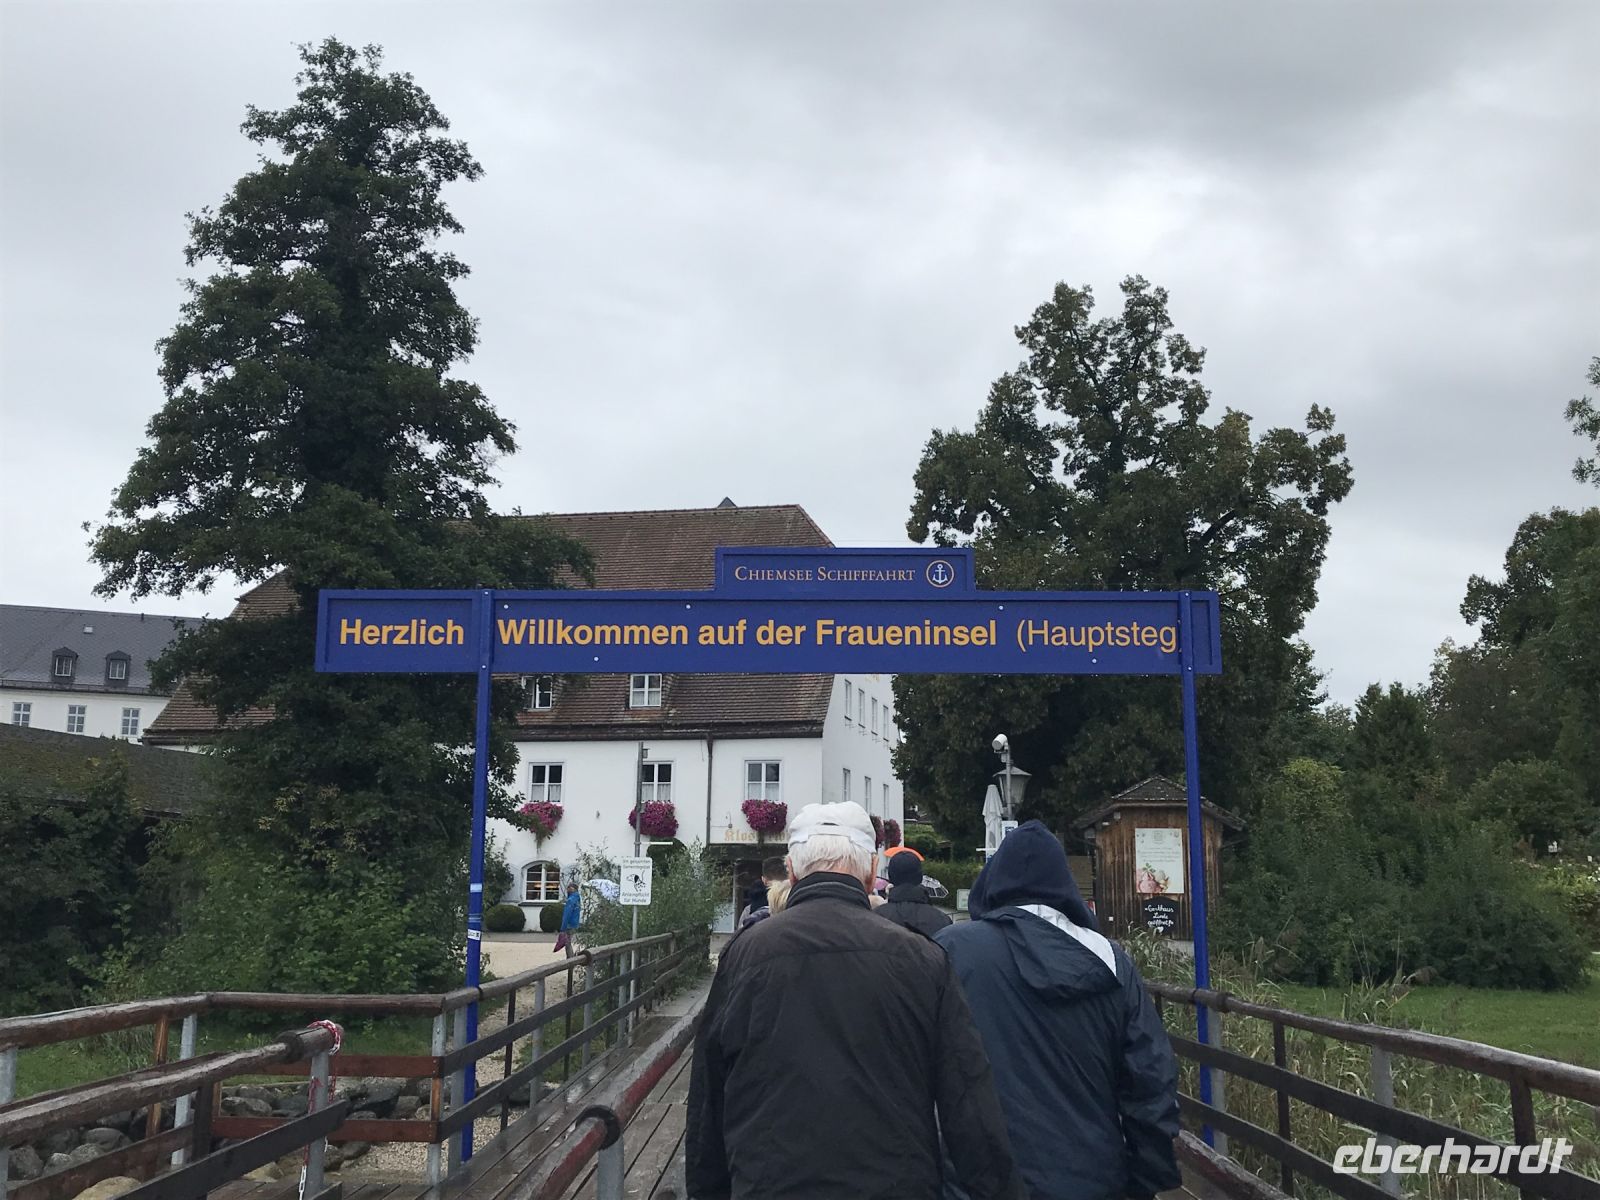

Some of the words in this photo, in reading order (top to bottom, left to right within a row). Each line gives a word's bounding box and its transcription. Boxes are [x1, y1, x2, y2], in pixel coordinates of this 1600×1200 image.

[735, 567, 812, 580] CHIEMSEE
[818, 567, 915, 580] SCHIFFFAHRT
[340, 619, 464, 644] Herzlich
[497, 619, 688, 644] Willkommen
[698, 619, 746, 644] auf
[756, 620, 805, 644] der
[816, 620, 996, 645] Fraueninsel
[1017, 621, 1182, 653] (Hauptsteg
